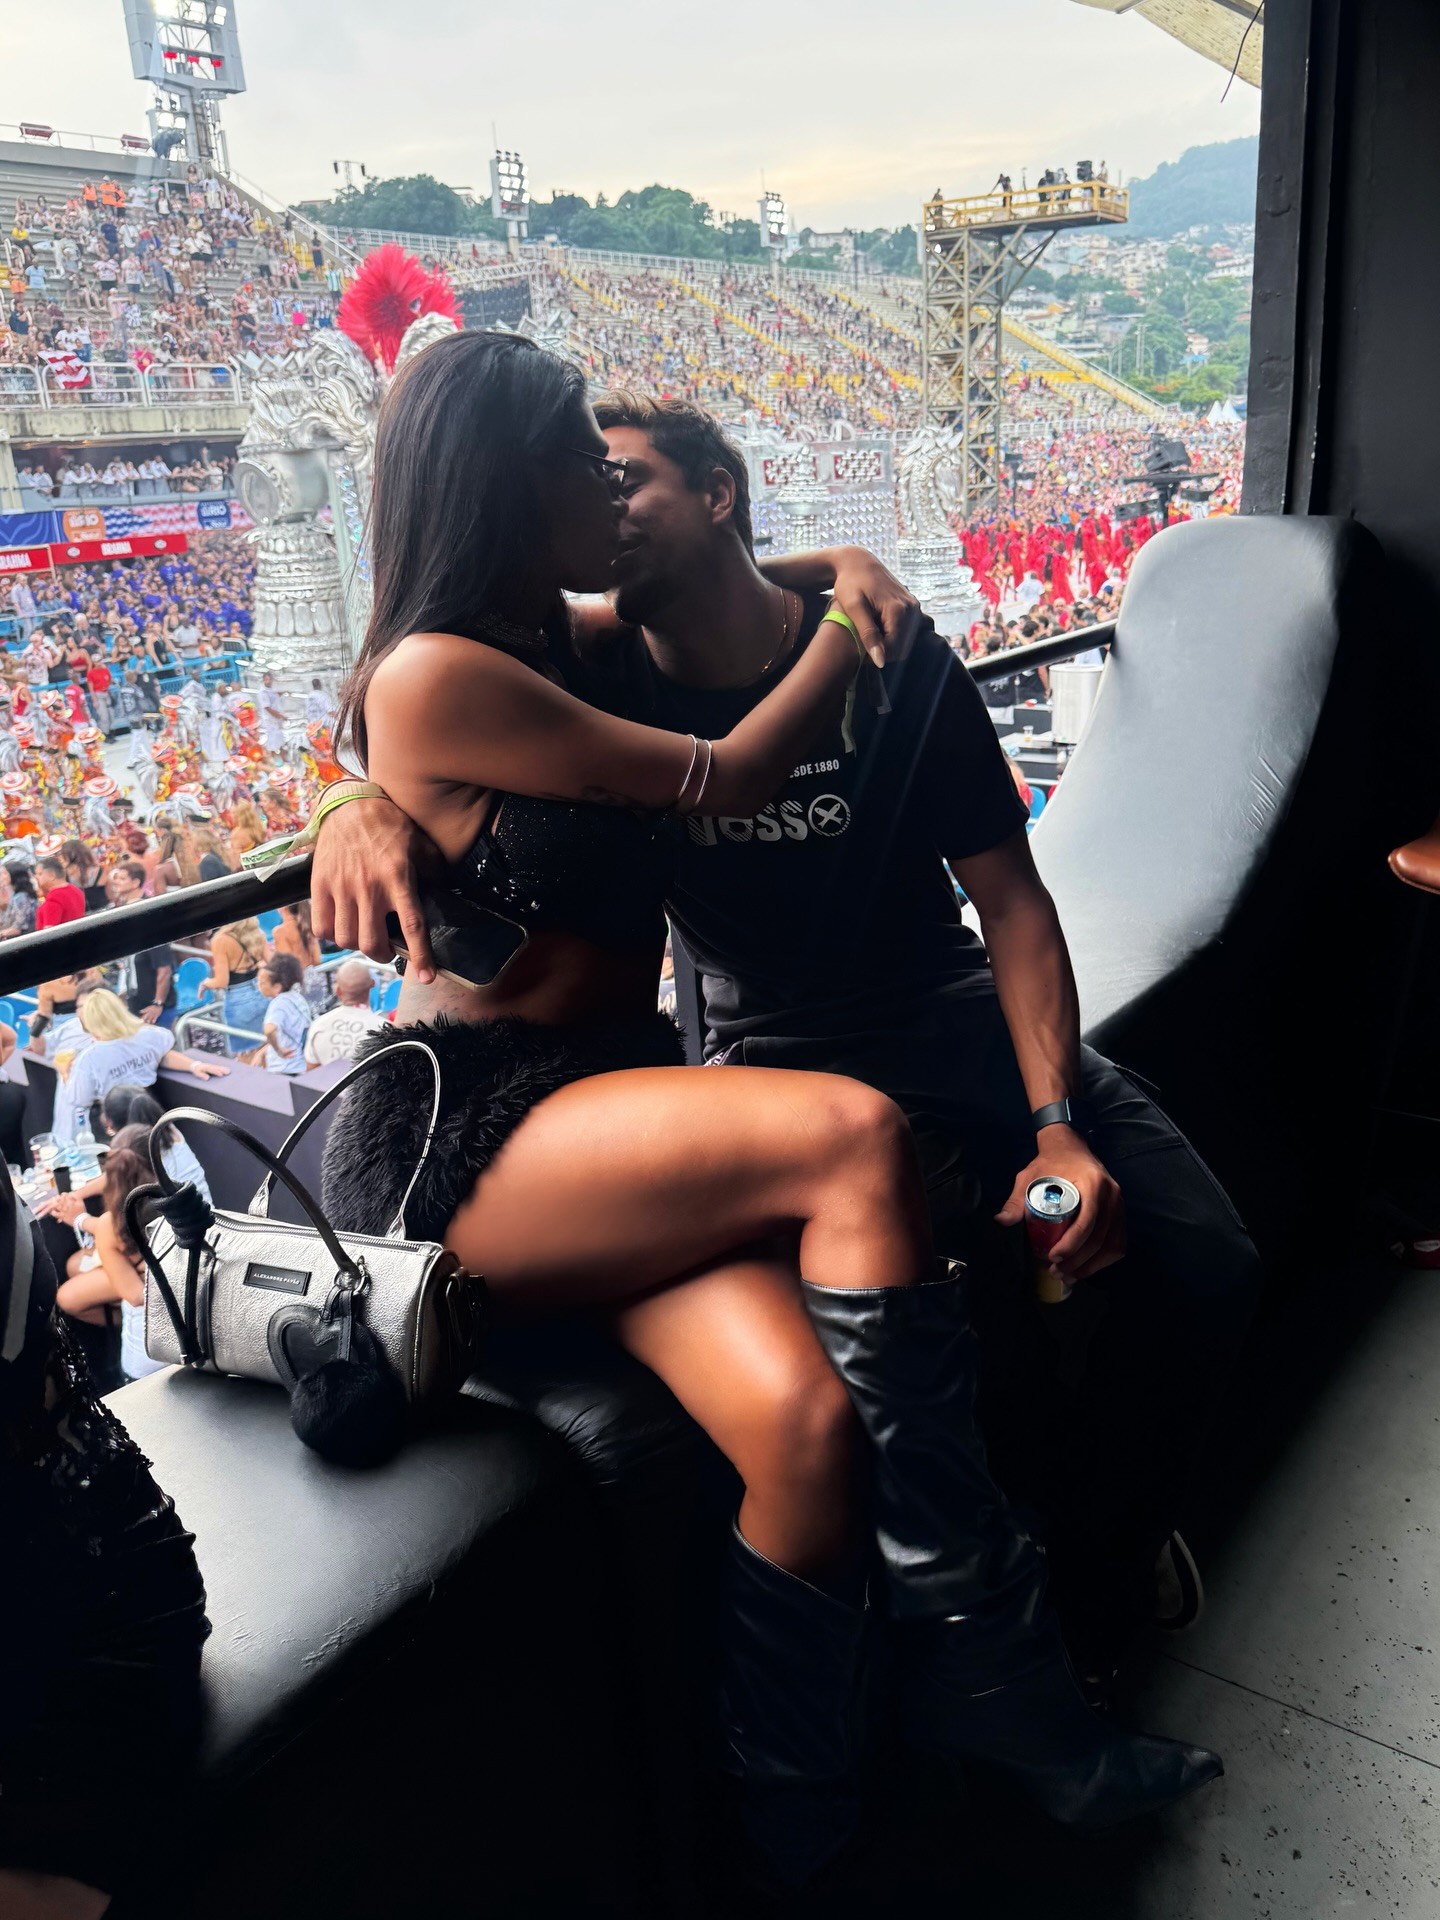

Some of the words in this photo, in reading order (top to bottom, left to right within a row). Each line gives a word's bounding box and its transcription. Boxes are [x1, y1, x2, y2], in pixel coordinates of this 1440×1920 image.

[0, 552, 32, 570] RAHMA
[790, 763, 813, 778] SDE
[814, 759, 840, 773] 1880
[253, 1273, 283, 1282] ALEXANDRE
